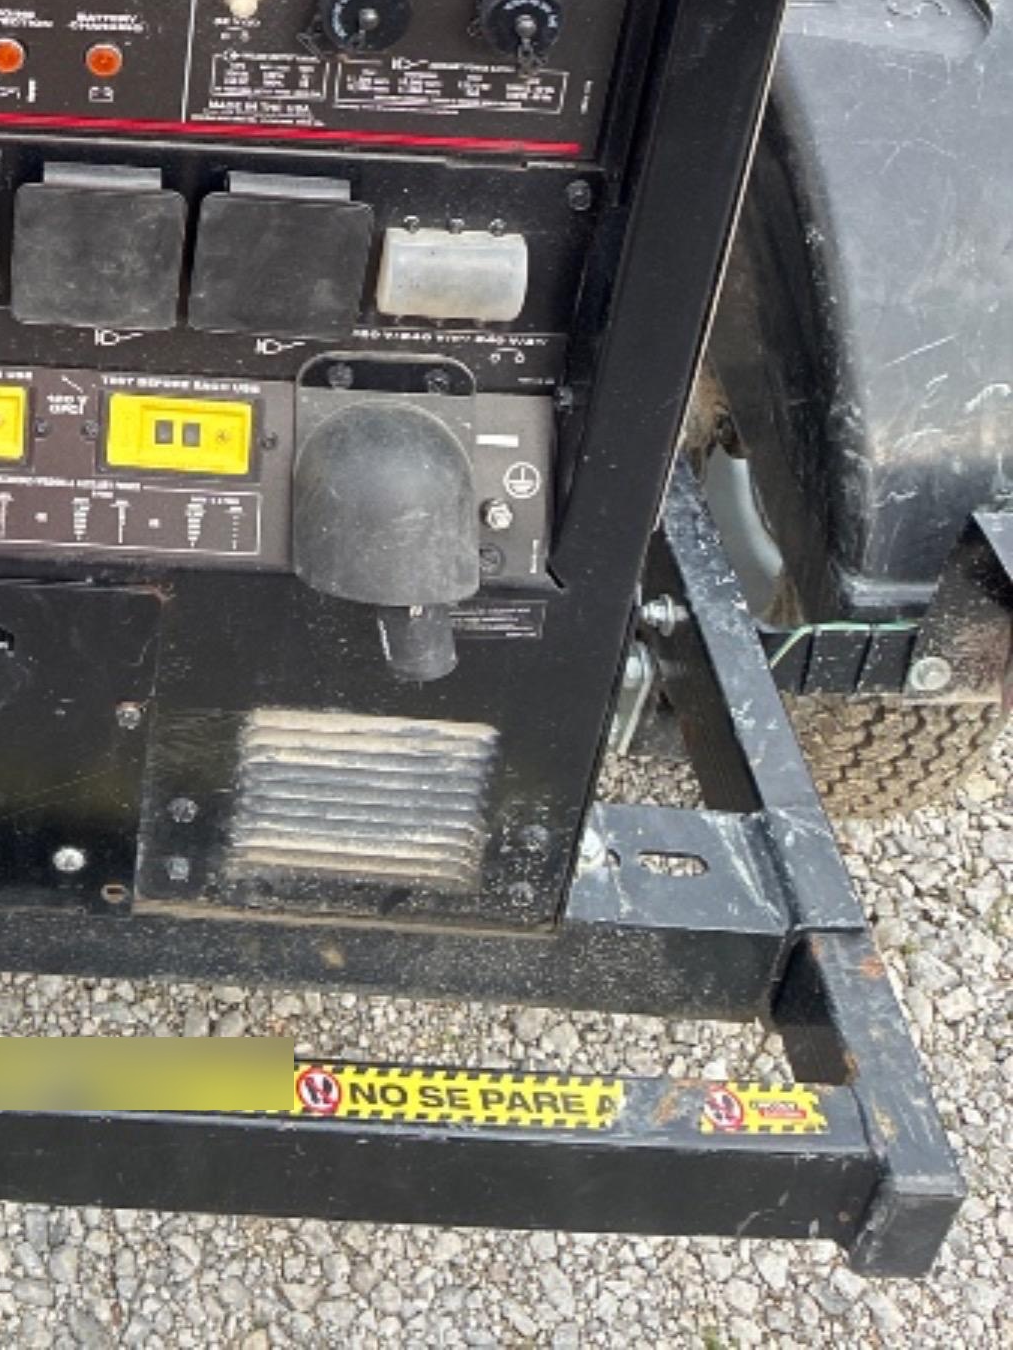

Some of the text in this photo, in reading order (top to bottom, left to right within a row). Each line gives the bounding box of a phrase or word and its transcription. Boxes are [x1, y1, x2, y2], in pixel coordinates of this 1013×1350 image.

[349, 1082, 409, 1106] NO
[418, 1085, 471, 1111] SE
[479, 1088, 588, 1115] PARE
